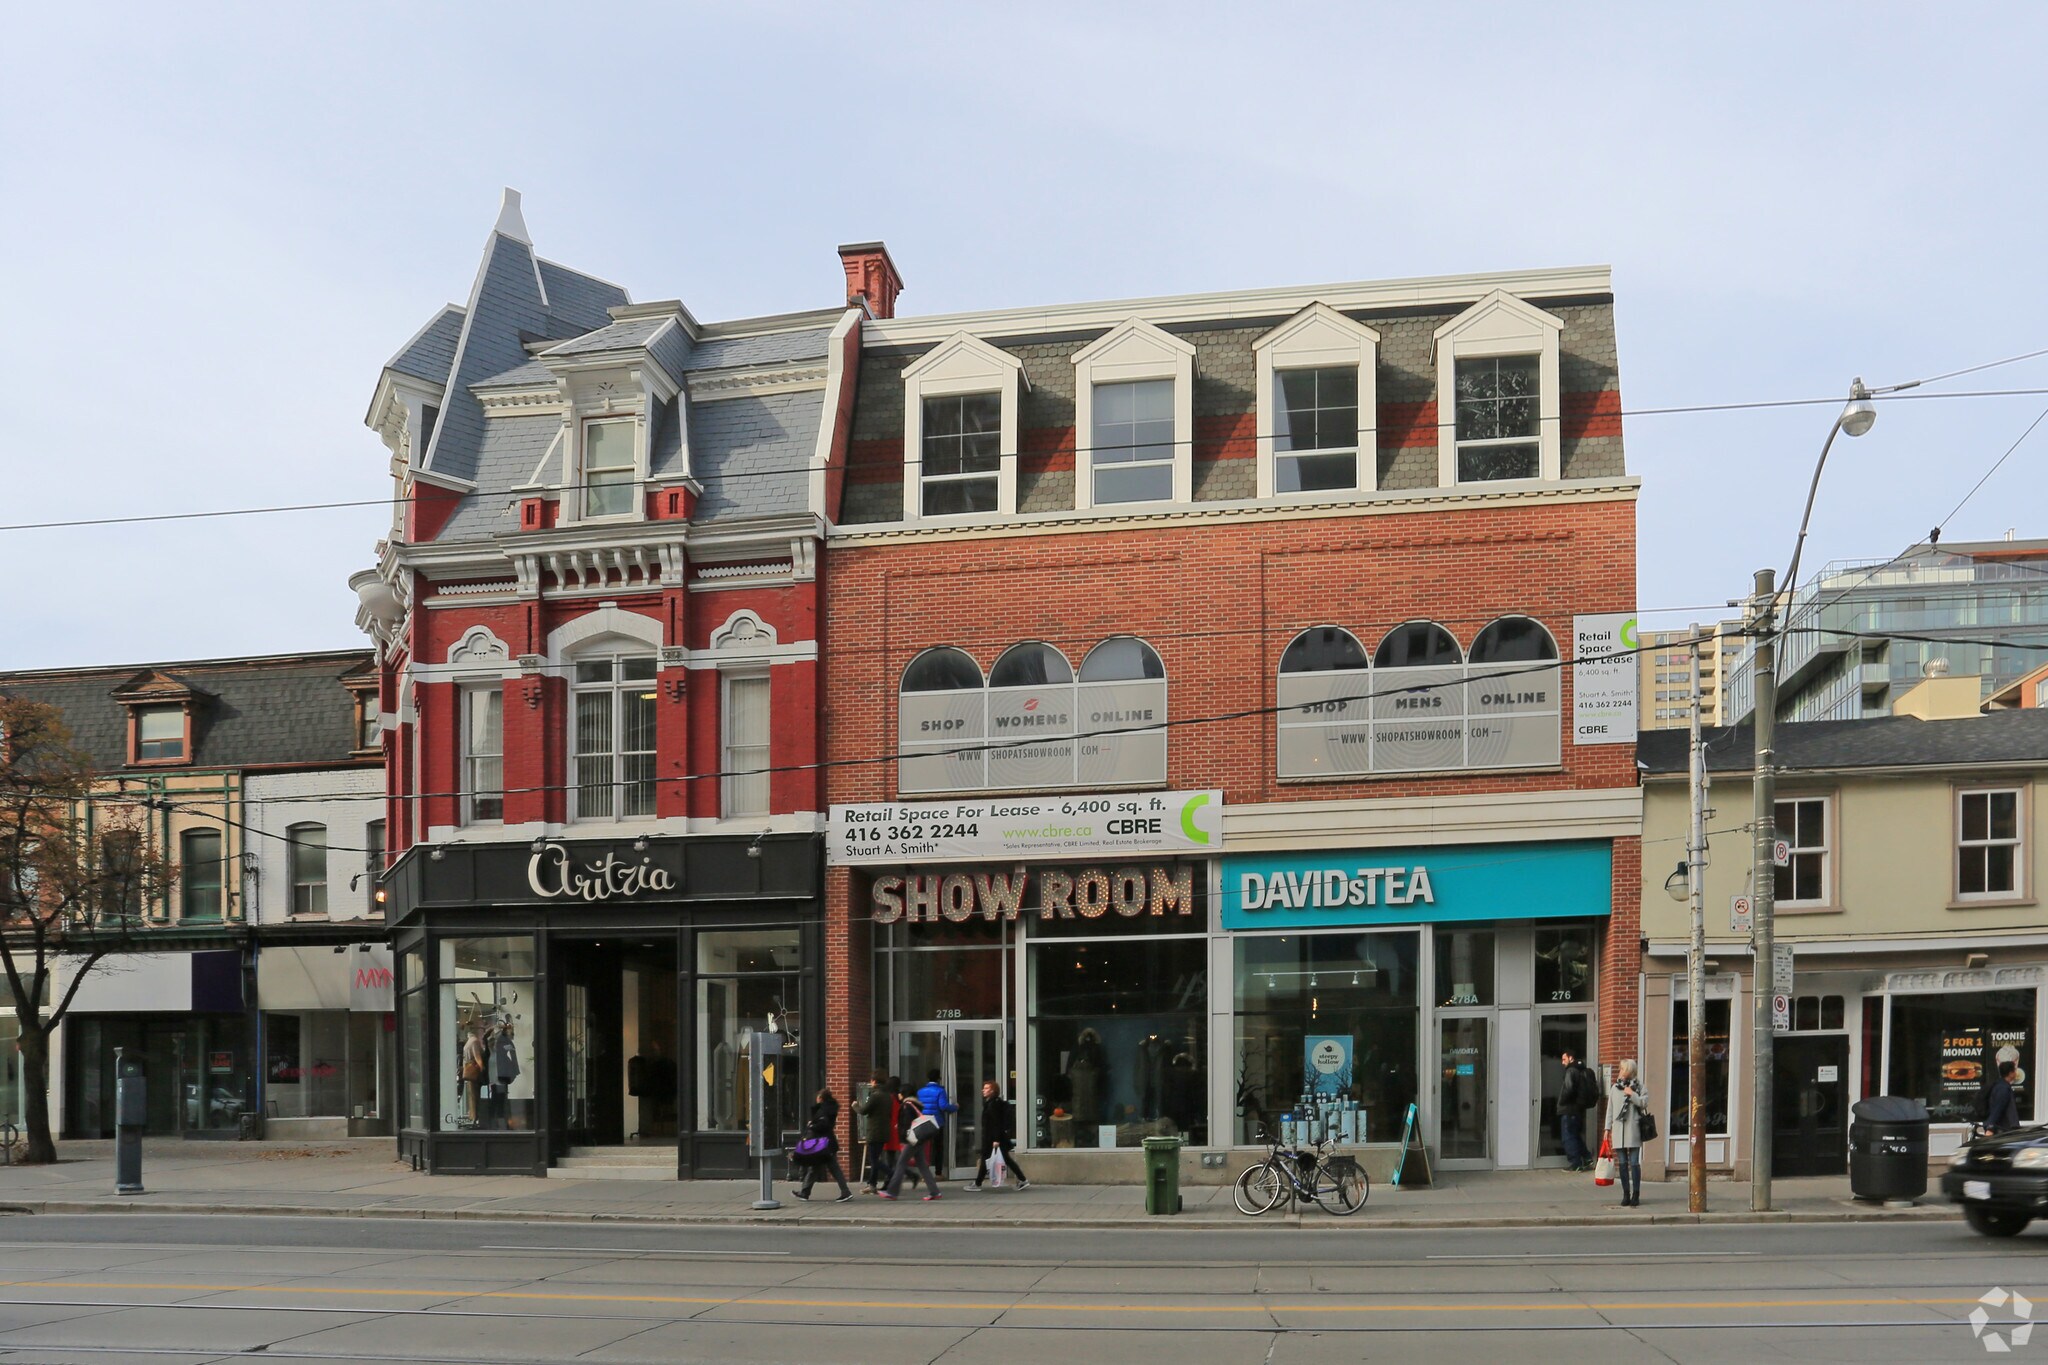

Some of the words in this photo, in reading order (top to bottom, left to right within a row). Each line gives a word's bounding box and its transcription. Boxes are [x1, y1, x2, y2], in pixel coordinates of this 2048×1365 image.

[1579, 631, 1611, 642] Retail
[1579, 645, 1612, 655] Space
[1579, 656, 1596, 666] For
[1601, 656, 1633, 665] Lease
[1579, 668, 1599, 676] 6,400
[1579, 691, 1600, 699] Stuart
[1302, 700, 1348, 714] SHOP
[1396, 696, 1442, 709] MENS
[1480, 692, 1546, 706] ONLINE
[1613, 700, 1632, 708] 2244
[920, 719, 965, 732] SHOP
[996, 713, 1069, 728] WOMENS
[1090, 709, 1153, 723] ONLINE
[1578, 725, 1609, 734] CBRE
[1341, 733, 1366, 744] WWW
[1376, 729, 1461, 743] SHOPATSHOWROOM
[1471, 727, 1489, 738] COM
[958, 751, 981, 761] WWW
[991, 747, 1071, 760] SHOPATSHOWROOM
[1081, 746, 1098, 756] COM
[845, 808, 892, 823] Retail
[899, 807, 949, 823] Space
[956, 806, 984, 818] For
[990, 804, 1040, 817] Lease
[1061, 800, 1111, 816] 6,400
[1117, 802, 1142, 814] sq.
[1149, 797, 1166, 811] ft.
[1002, 824, 1092, 838] www.cbre.ca
[1106, 818, 1161, 835] CBRE
[845, 827, 881, 842] 416
[887, 825, 923, 840] 362
[930, 823, 979, 839] 2244
[846, 844, 881, 857] Stuart
[884, 844, 897, 855] A.
[528, 843, 677, 901] Aritzia
[1241, 865, 1435, 910] DAVIDsTEA
[872, 872, 1028, 924] SHOW
[1040, 865, 1193, 920] ROOM
[1452, 994, 1479, 1004] 278A
[1551, 990, 1571, 1000] 276
[936, 1009, 962, 1019] 278B
[1991, 1032, 2026, 1040] TOONIE
[1943, 1039, 1950, 1047] 2
[1952, 1038, 1974, 1047] FOR
[1976, 1037, 1983, 1046] 1
[1943, 1048, 1983, 1056] MONDAY
